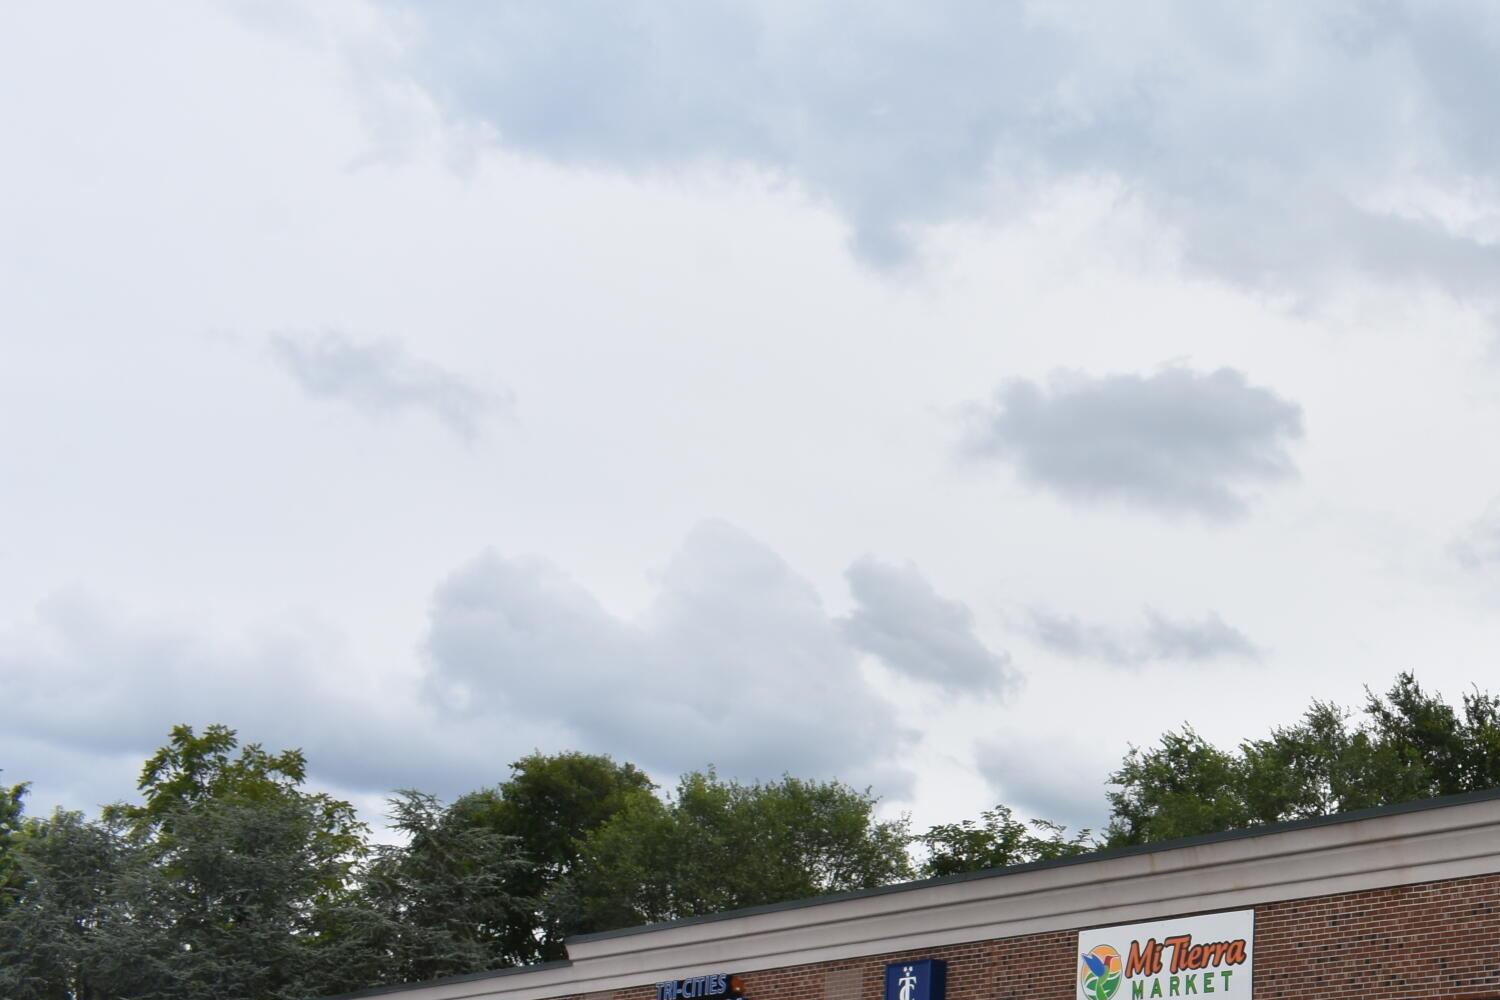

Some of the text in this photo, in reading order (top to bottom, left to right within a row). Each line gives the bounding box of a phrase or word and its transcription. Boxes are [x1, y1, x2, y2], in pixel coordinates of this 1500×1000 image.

[1125, 933, 1247, 979] Mi Tierra
[1131, 970, 1233, 1000] MARKET
